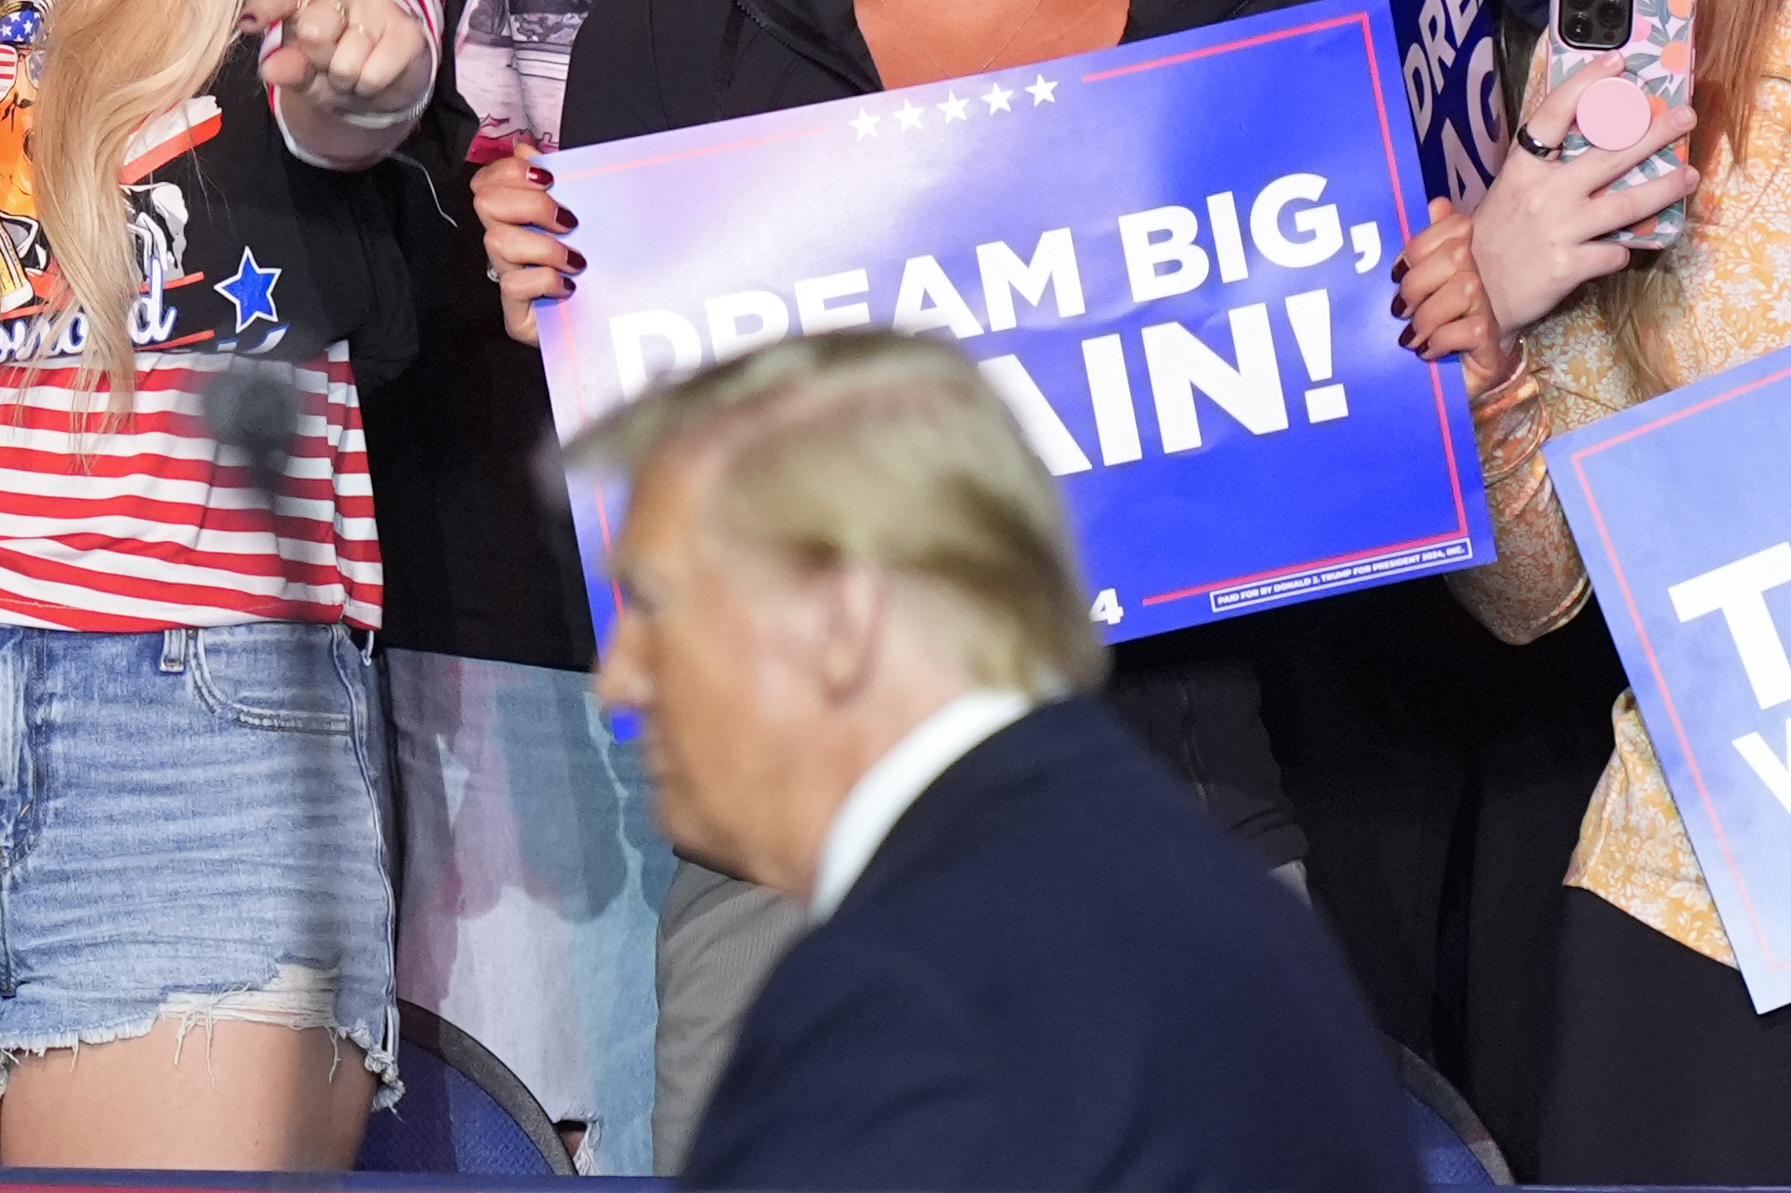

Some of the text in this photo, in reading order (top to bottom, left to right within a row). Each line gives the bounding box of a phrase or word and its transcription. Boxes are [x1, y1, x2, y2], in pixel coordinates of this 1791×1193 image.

[1117, 172, 1383, 304] BIG,
[976, 287, 1350, 477] AIN!
[1218, 593, 1239, 605] PAID
[1240, 589, 1259, 600] FOR
[1273, 577, 1311, 592] DONALD
[1321, 568, 1352, 582] TRUMP
[1353, 565, 1372, 576] FOR
[1372, 554, 1421, 572] PRESIDENT
